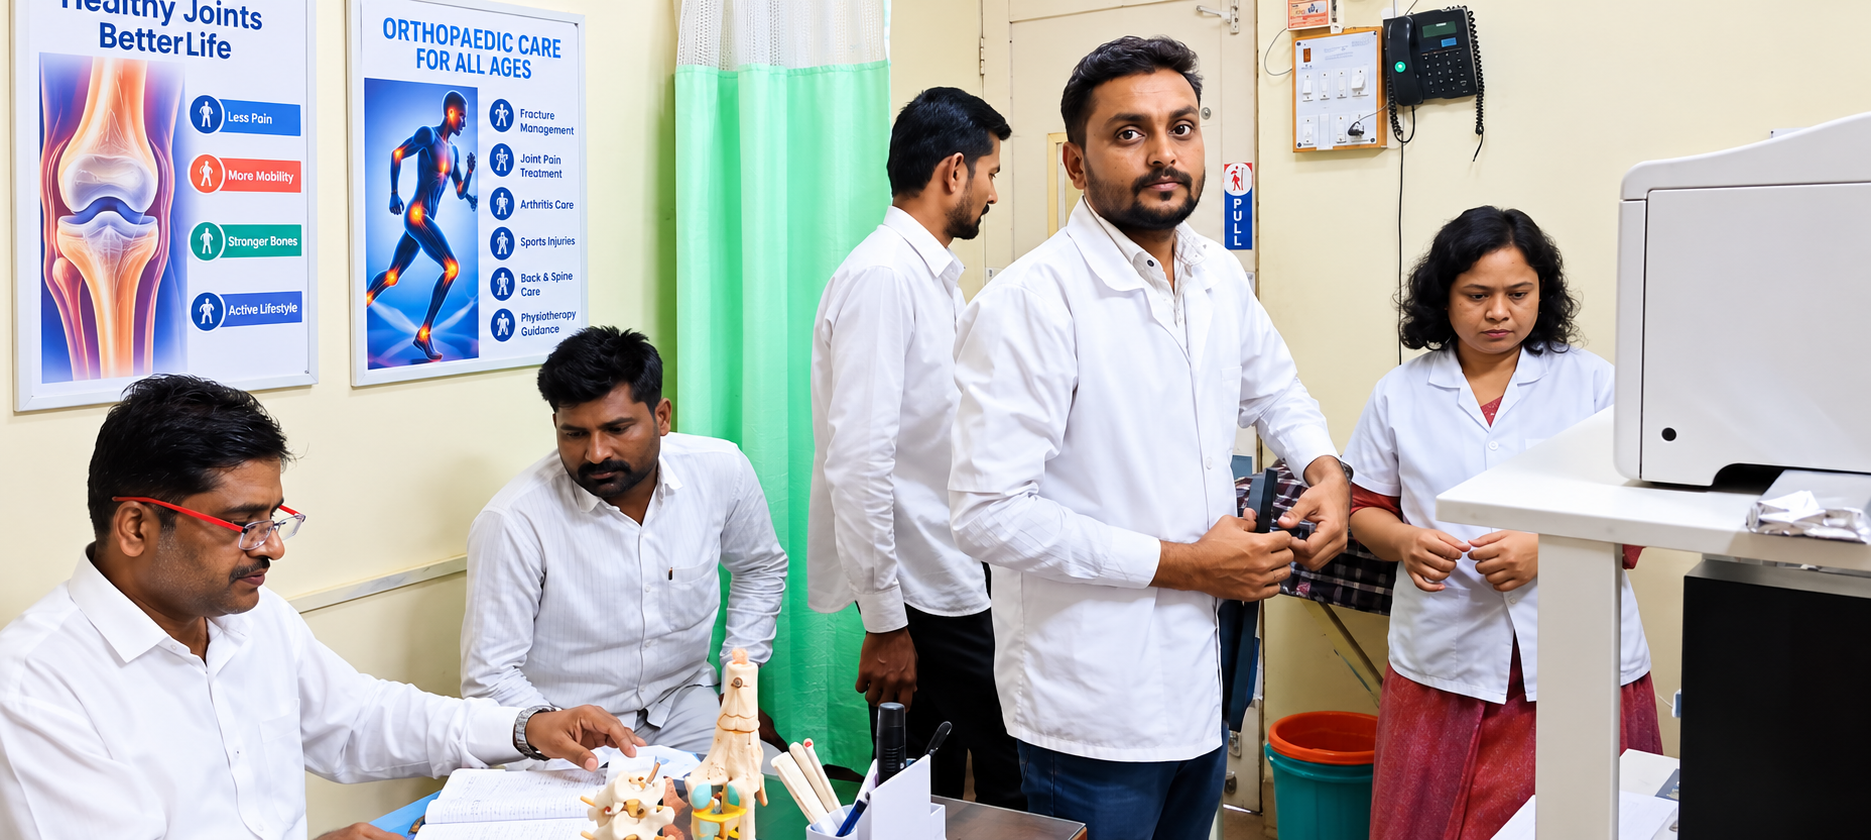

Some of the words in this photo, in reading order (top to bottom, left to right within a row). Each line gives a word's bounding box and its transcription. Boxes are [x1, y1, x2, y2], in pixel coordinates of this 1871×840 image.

[184, 0, 262, 30] Joints
[382, 17, 513, 53] ORTHOPAEDIC
[517, 34, 562, 59] CARE
[416, 48, 450, 72] FOR
[455, 51, 486, 75] ALL
[489, 56, 532, 79] AGES
[227, 111, 250, 123] Less
[251, 112, 273, 125] Pain
[520, 108, 556, 121] Fracture
[520, 122, 575, 137] Management
[520, 153, 542, 164] Joint
[543, 154, 562, 165] Pain
[228, 169, 254, 181] More
[255, 170, 295, 185] Mobility
[519, 167, 563, 179] Treatment
[519, 199, 554, 210] Arthritis
[554, 199, 575, 210] Care
[1233, 198, 1243, 246] PULL
[228, 235, 269, 250] Stronger
[269, 235, 298, 247] Bones
[520, 236, 547, 249] Sports
[547, 235, 576, 249] Injuries
[520, 272, 542, 283] Back
[542, 272, 549, 282] &
[550, 271, 574, 283] Spine
[520, 286, 541, 297] Care
[228, 304, 259, 316] Active
[259, 302, 298, 316] Lifestyle
[520, 310, 577, 324] Physiotherapy
[520, 325, 560, 337] Guidance
